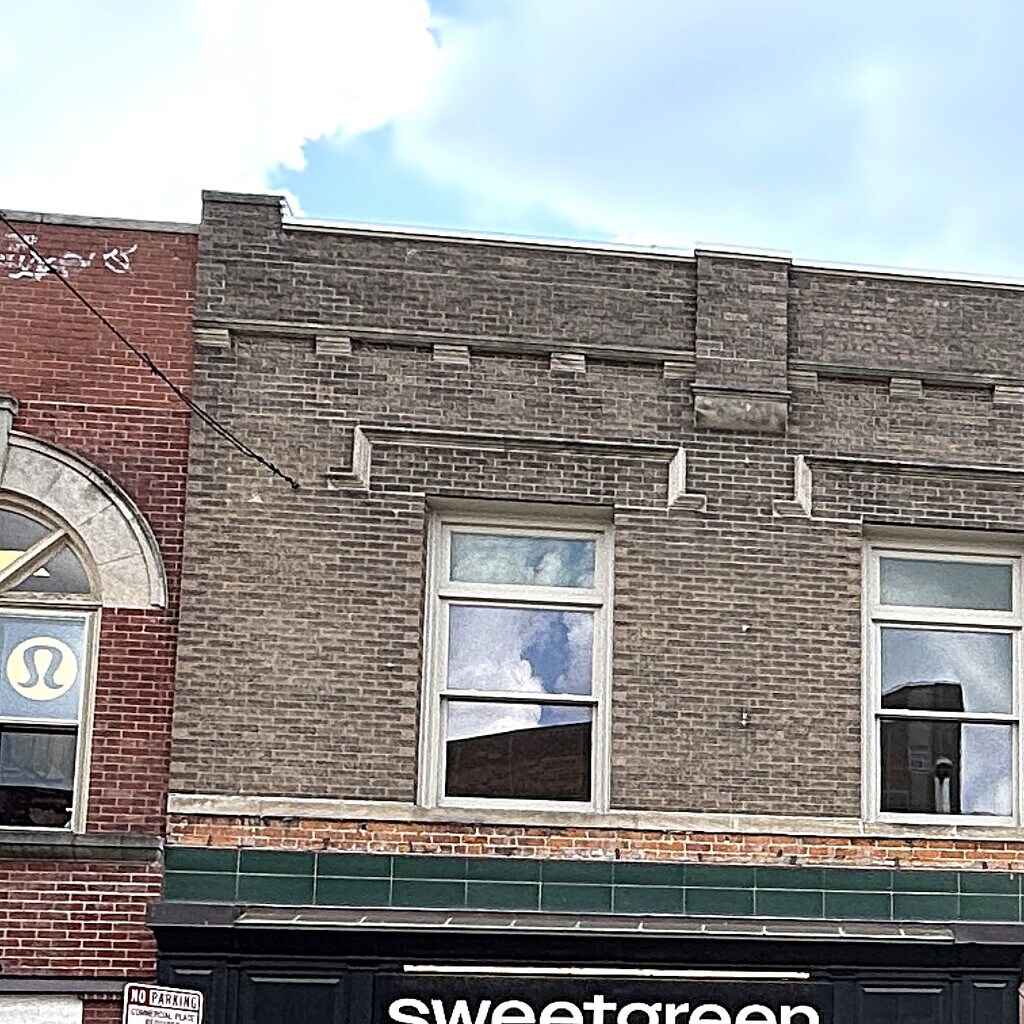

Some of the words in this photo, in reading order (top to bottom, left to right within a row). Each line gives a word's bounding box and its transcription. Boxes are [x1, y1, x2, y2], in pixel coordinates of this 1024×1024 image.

[130, 988, 147, 1005] NO
[151, 992, 197, 1009] PARKING
[174, 1013, 195, 1022] PLATE
